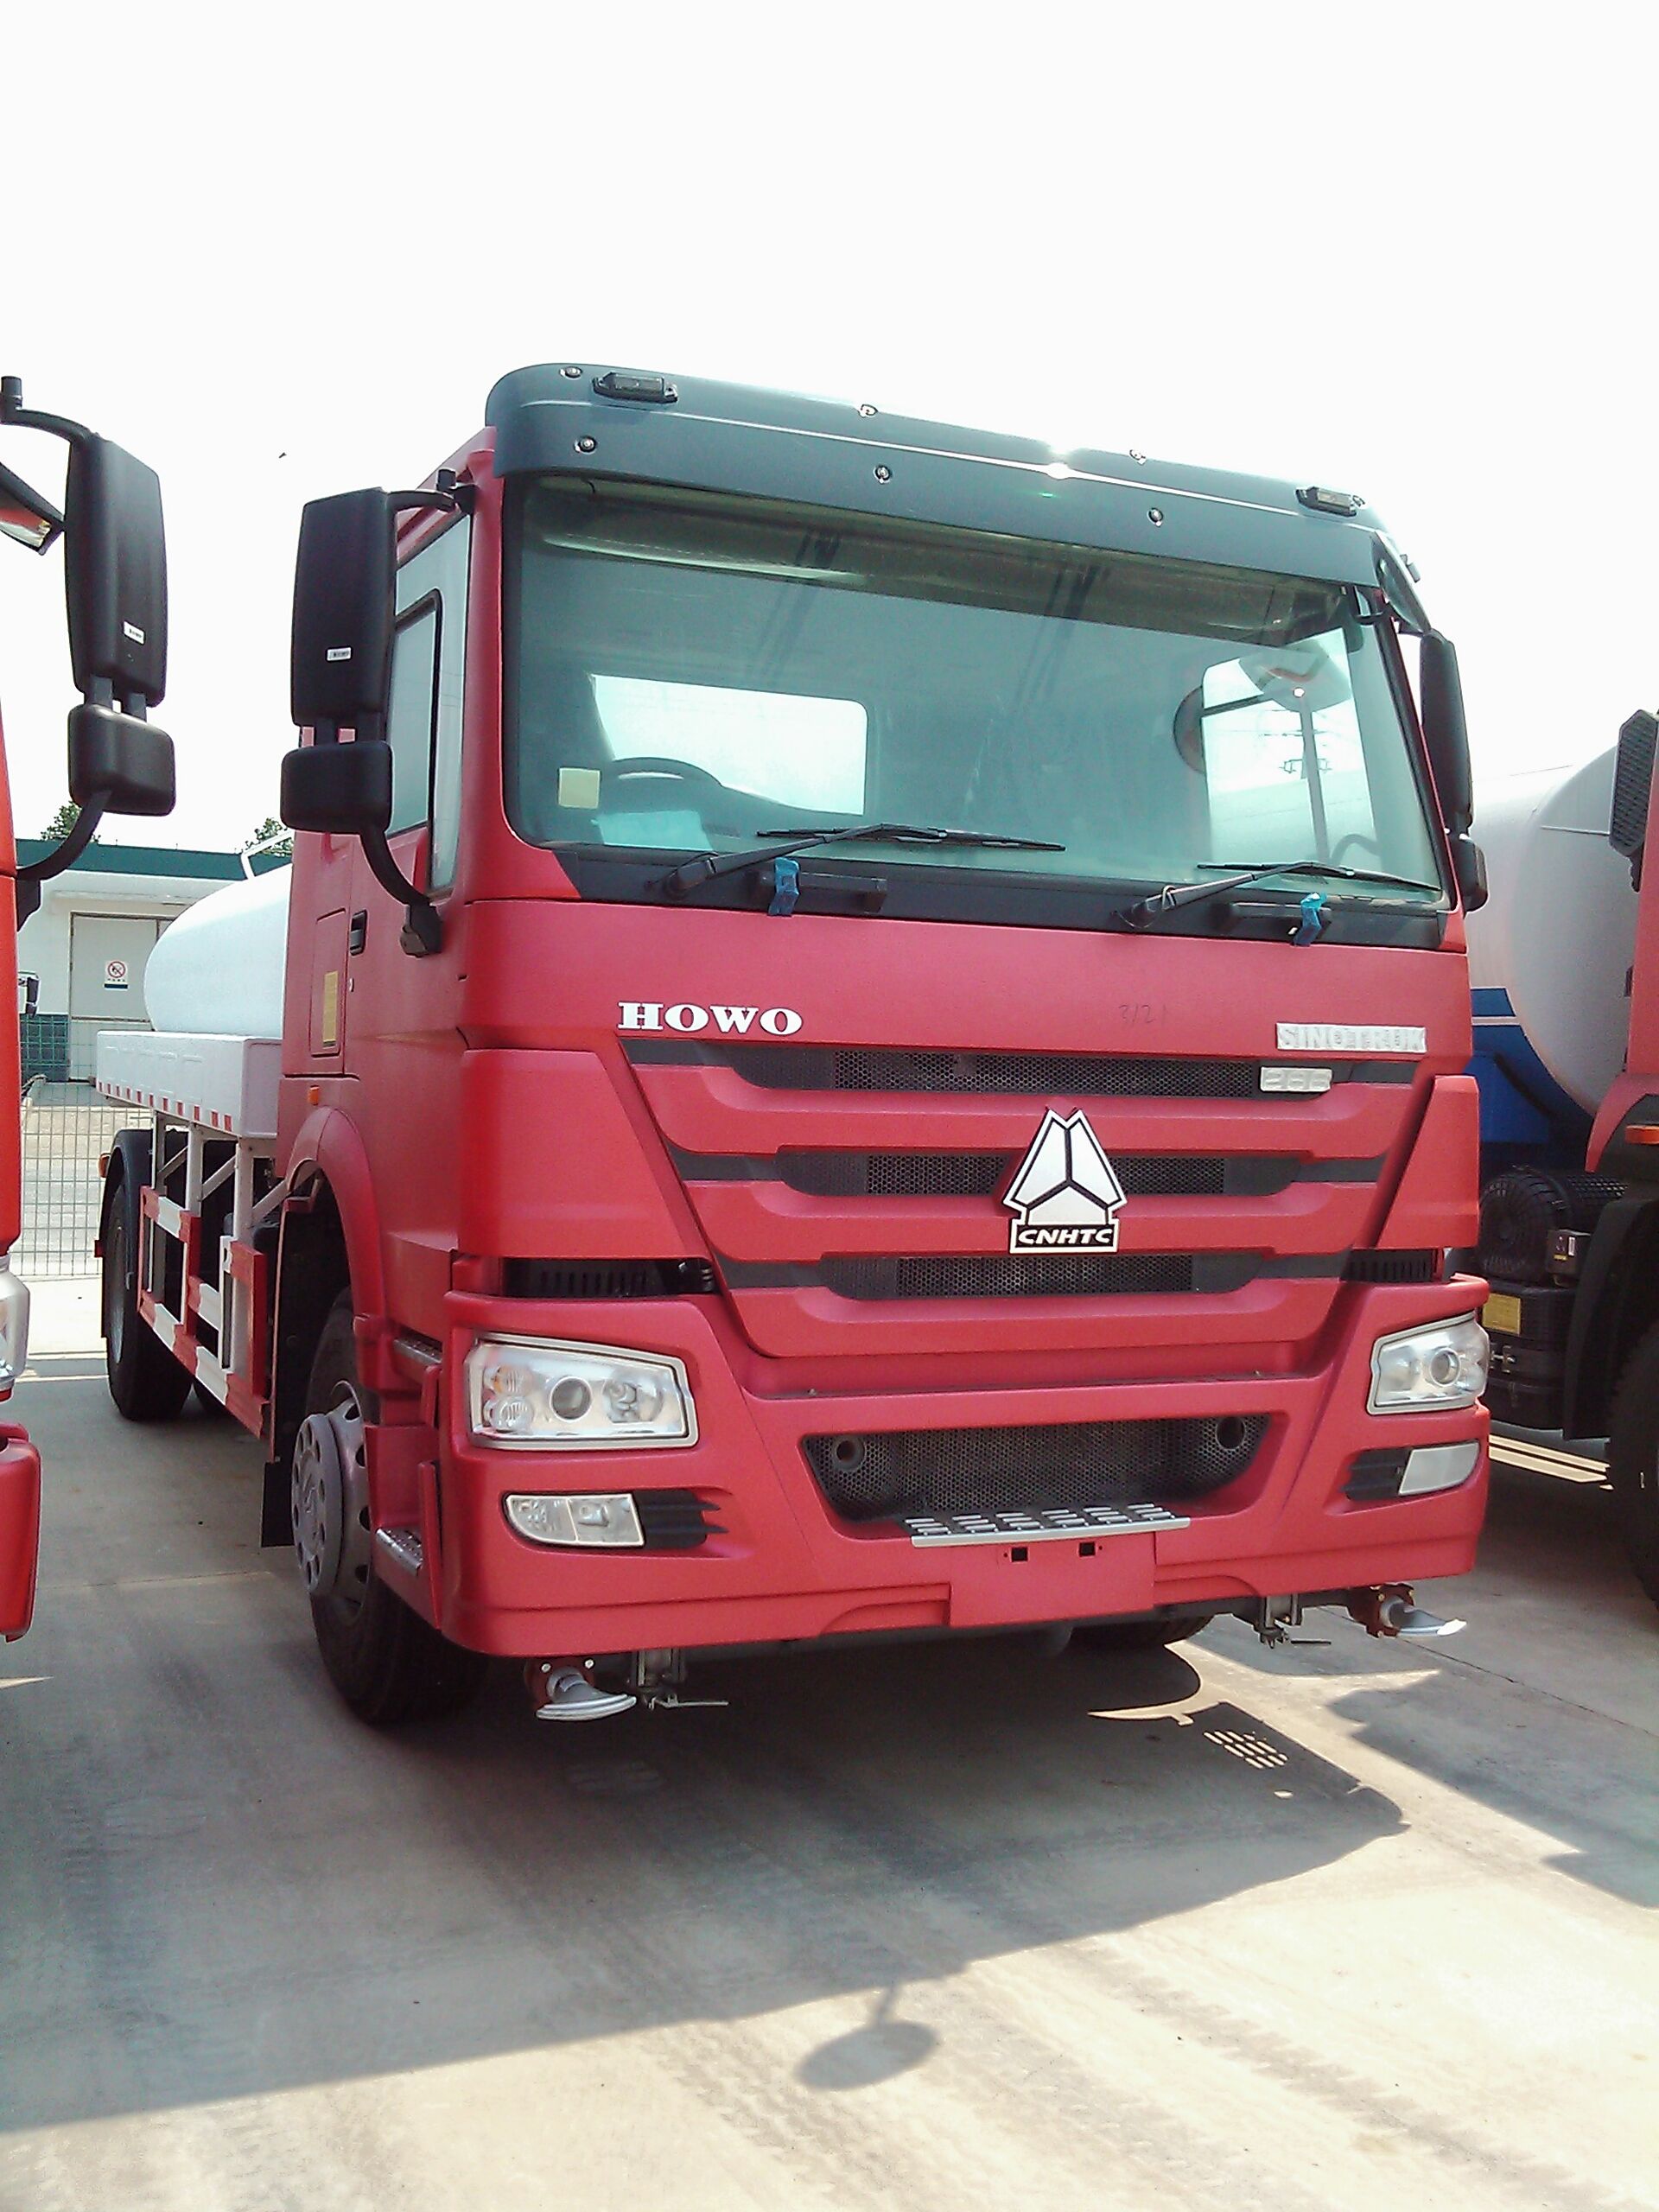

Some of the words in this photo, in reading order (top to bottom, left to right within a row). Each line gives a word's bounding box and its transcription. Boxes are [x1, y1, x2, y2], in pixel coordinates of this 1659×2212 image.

[617, 1001, 804, 1036] HOWO
[1279, 1025, 1425, 1052] SINOTRUK
[1017, 1228, 1113, 1245] CNHTC
